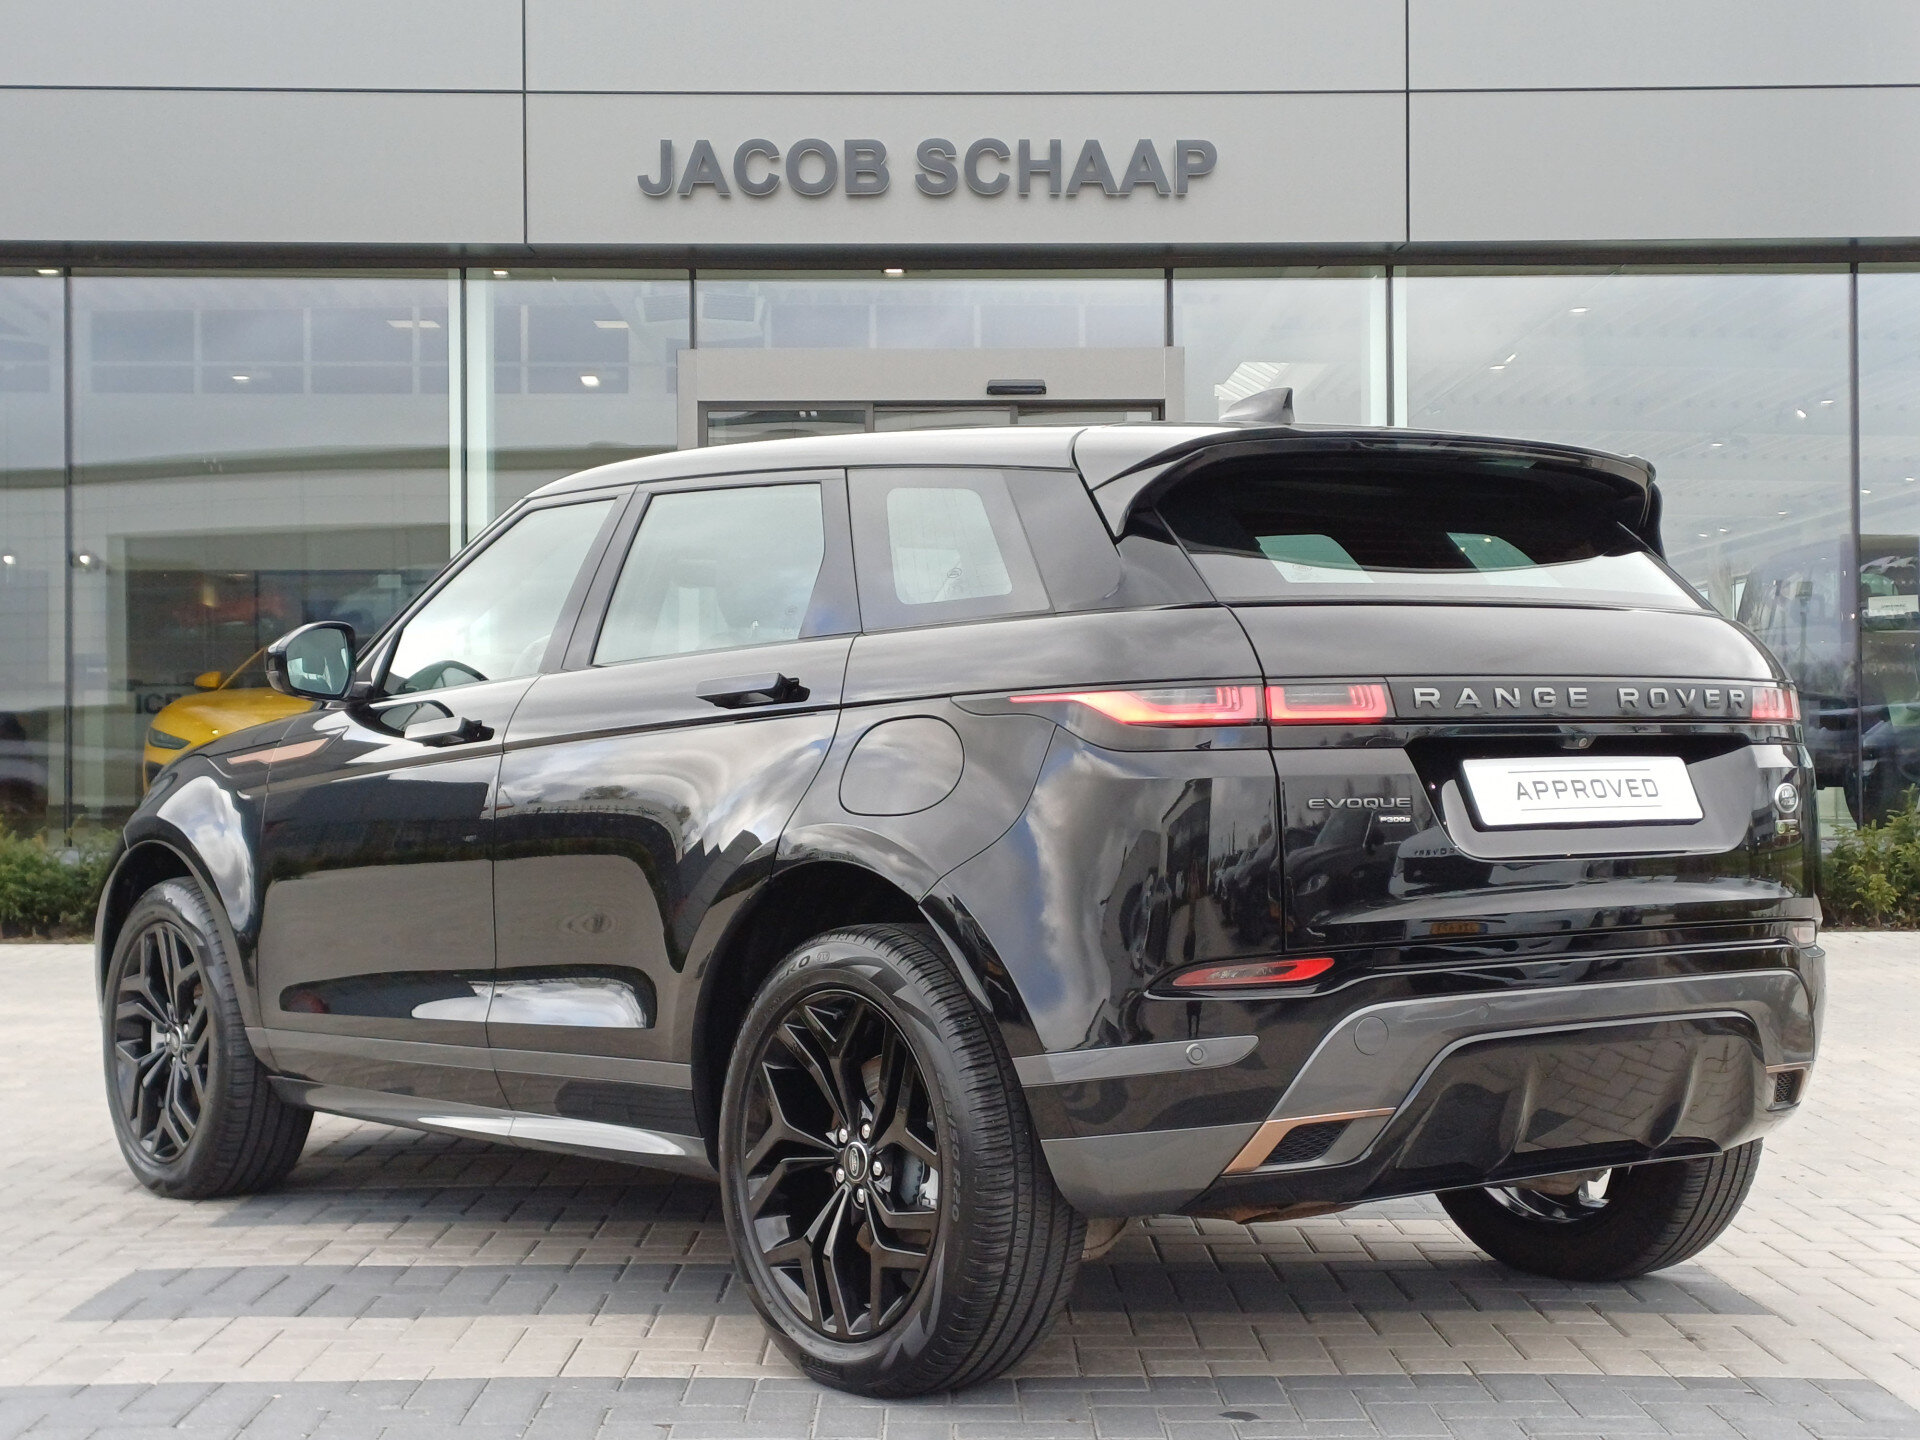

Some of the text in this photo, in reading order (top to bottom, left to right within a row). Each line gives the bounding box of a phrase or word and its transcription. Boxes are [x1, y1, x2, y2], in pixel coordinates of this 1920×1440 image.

[637, 137, 1218, 197] JACOB SCHAAP
[1412, 686, 1747, 710] RANGE ROVER
[1515, 777, 1660, 801] APPROVED
[1307, 796, 1412, 811] EVOQUE
